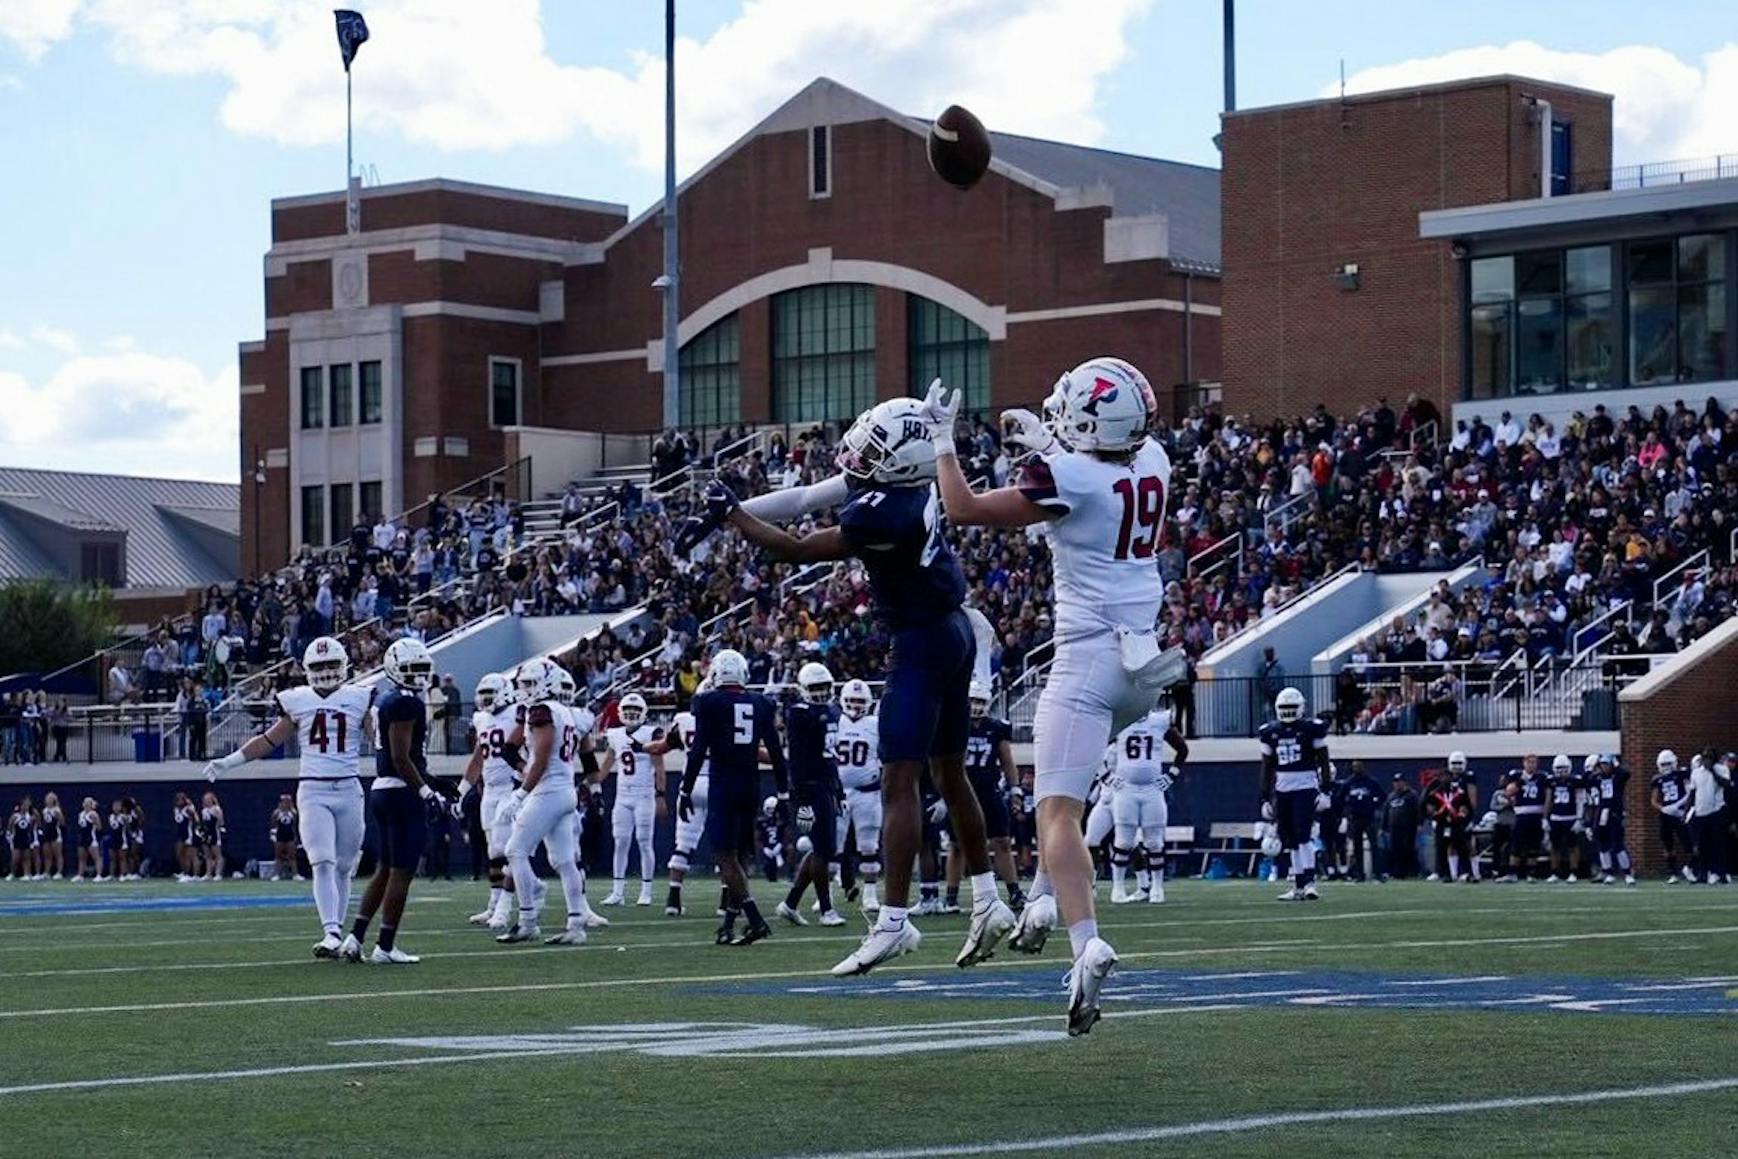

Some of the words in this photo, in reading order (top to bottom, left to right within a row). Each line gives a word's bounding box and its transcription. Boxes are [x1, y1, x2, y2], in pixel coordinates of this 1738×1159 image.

[1113, 476, 1164, 560] 19
[309, 711, 346, 753] 41
[734, 703, 754, 744] 5
[480, 728, 504, 758] 69
[836, 740, 869, 767] 50
[1126, 735, 1153, 760] 61
[621, 751, 635, 775] 9
